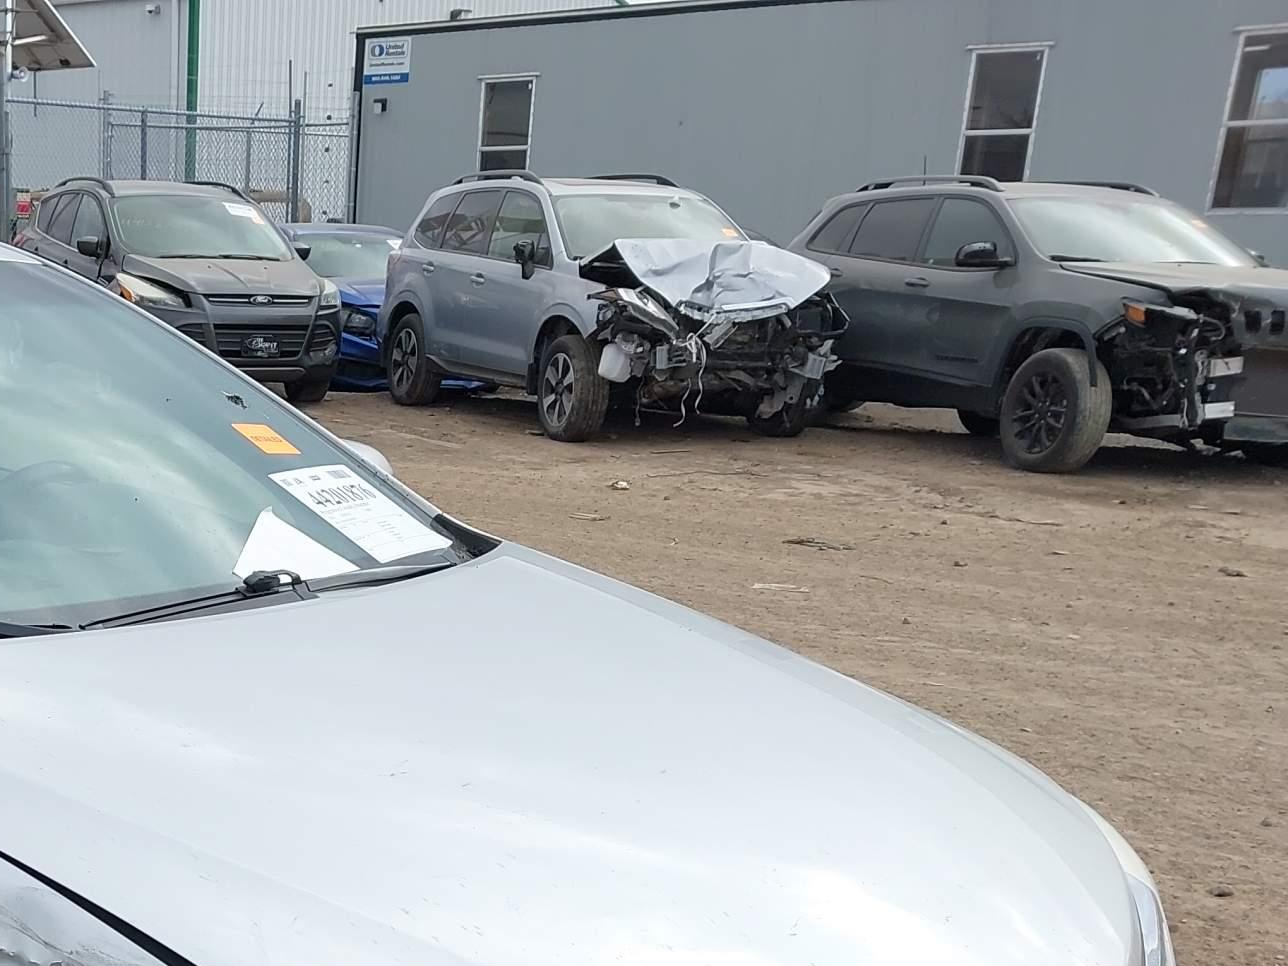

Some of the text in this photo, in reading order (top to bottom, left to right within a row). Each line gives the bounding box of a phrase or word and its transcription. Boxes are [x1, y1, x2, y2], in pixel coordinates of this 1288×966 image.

[386, 41, 405, 50] United
[385, 49, 406, 57] Rentals
[307, 483, 377, 507] 44201876
